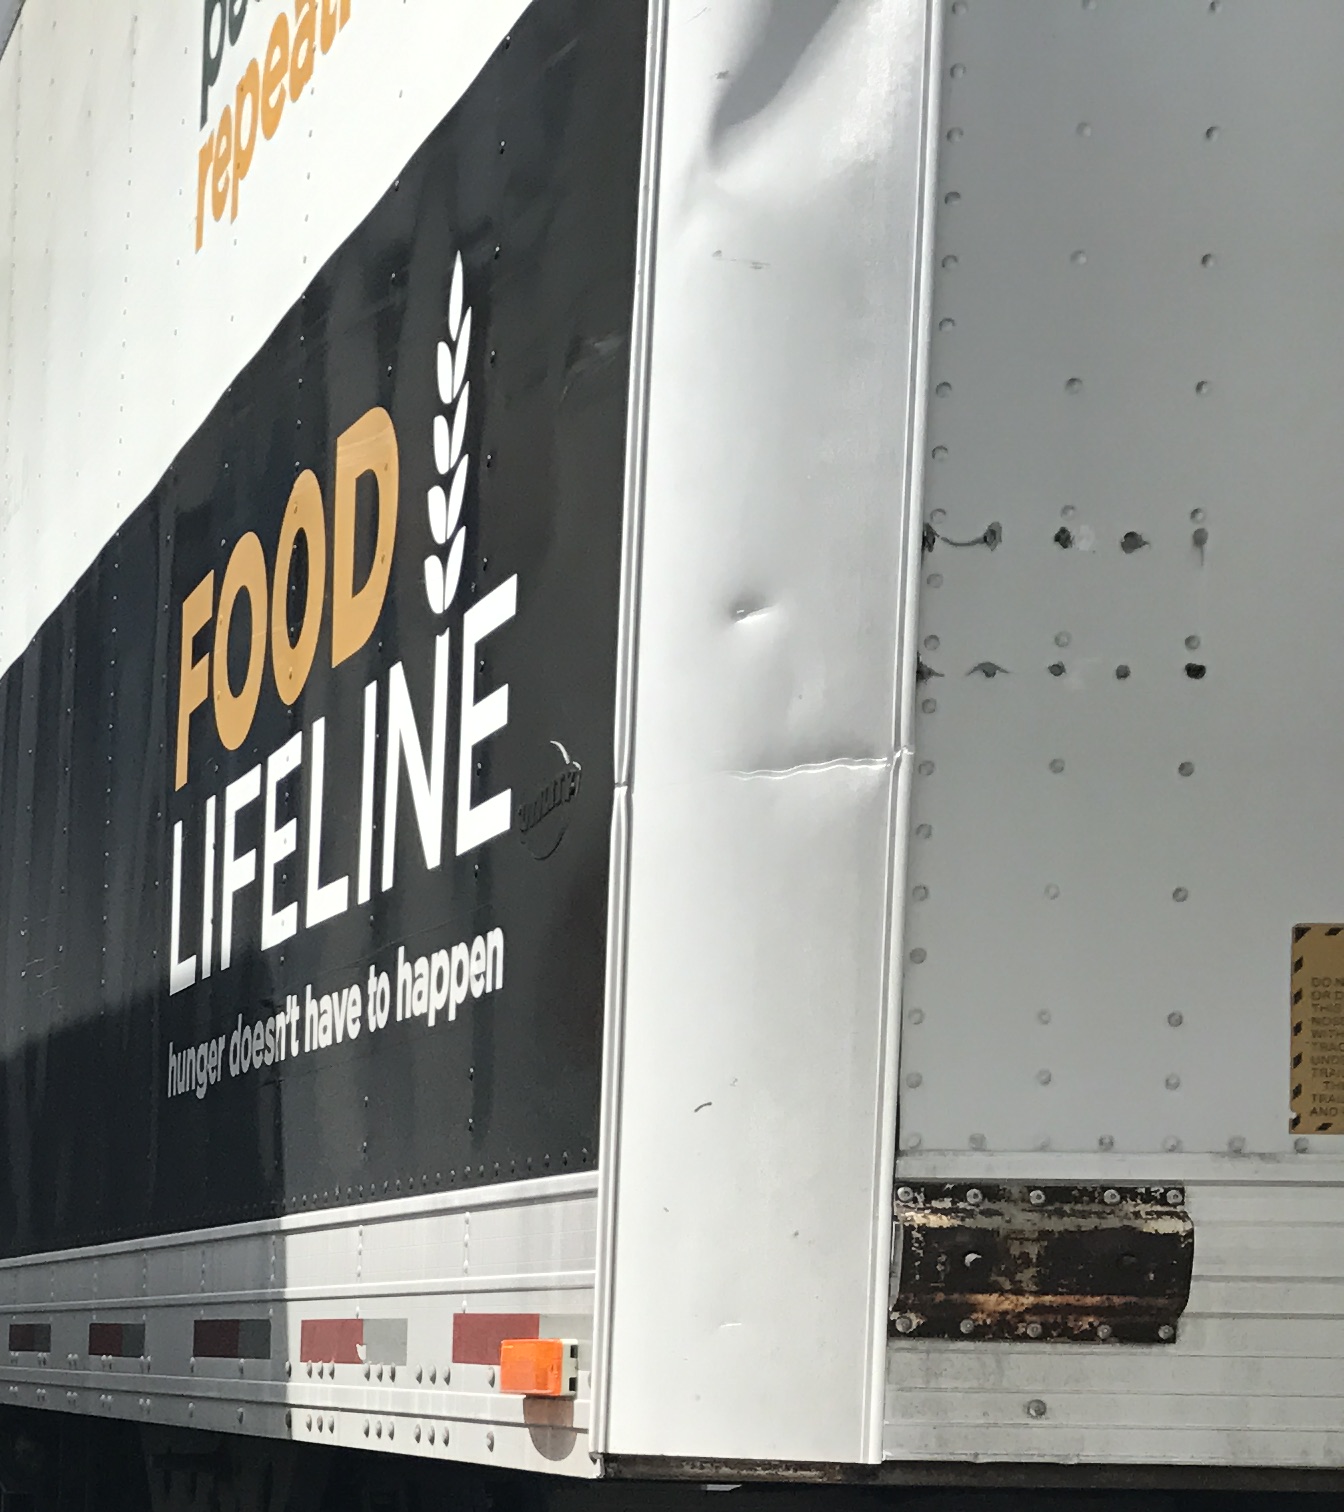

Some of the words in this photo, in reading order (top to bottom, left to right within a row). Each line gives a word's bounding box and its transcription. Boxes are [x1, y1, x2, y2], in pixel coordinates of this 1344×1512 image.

[169, 573, 518, 997] LIFELINE
[175, 406, 400, 791] FOOD
[167, 1042, 226, 1099] hunger
[229, 994, 300, 1077] doesn't
[304, 984, 362, 1052] have
[367, 964, 391, 1033] to
[396, 927, 504, 1027] happen
